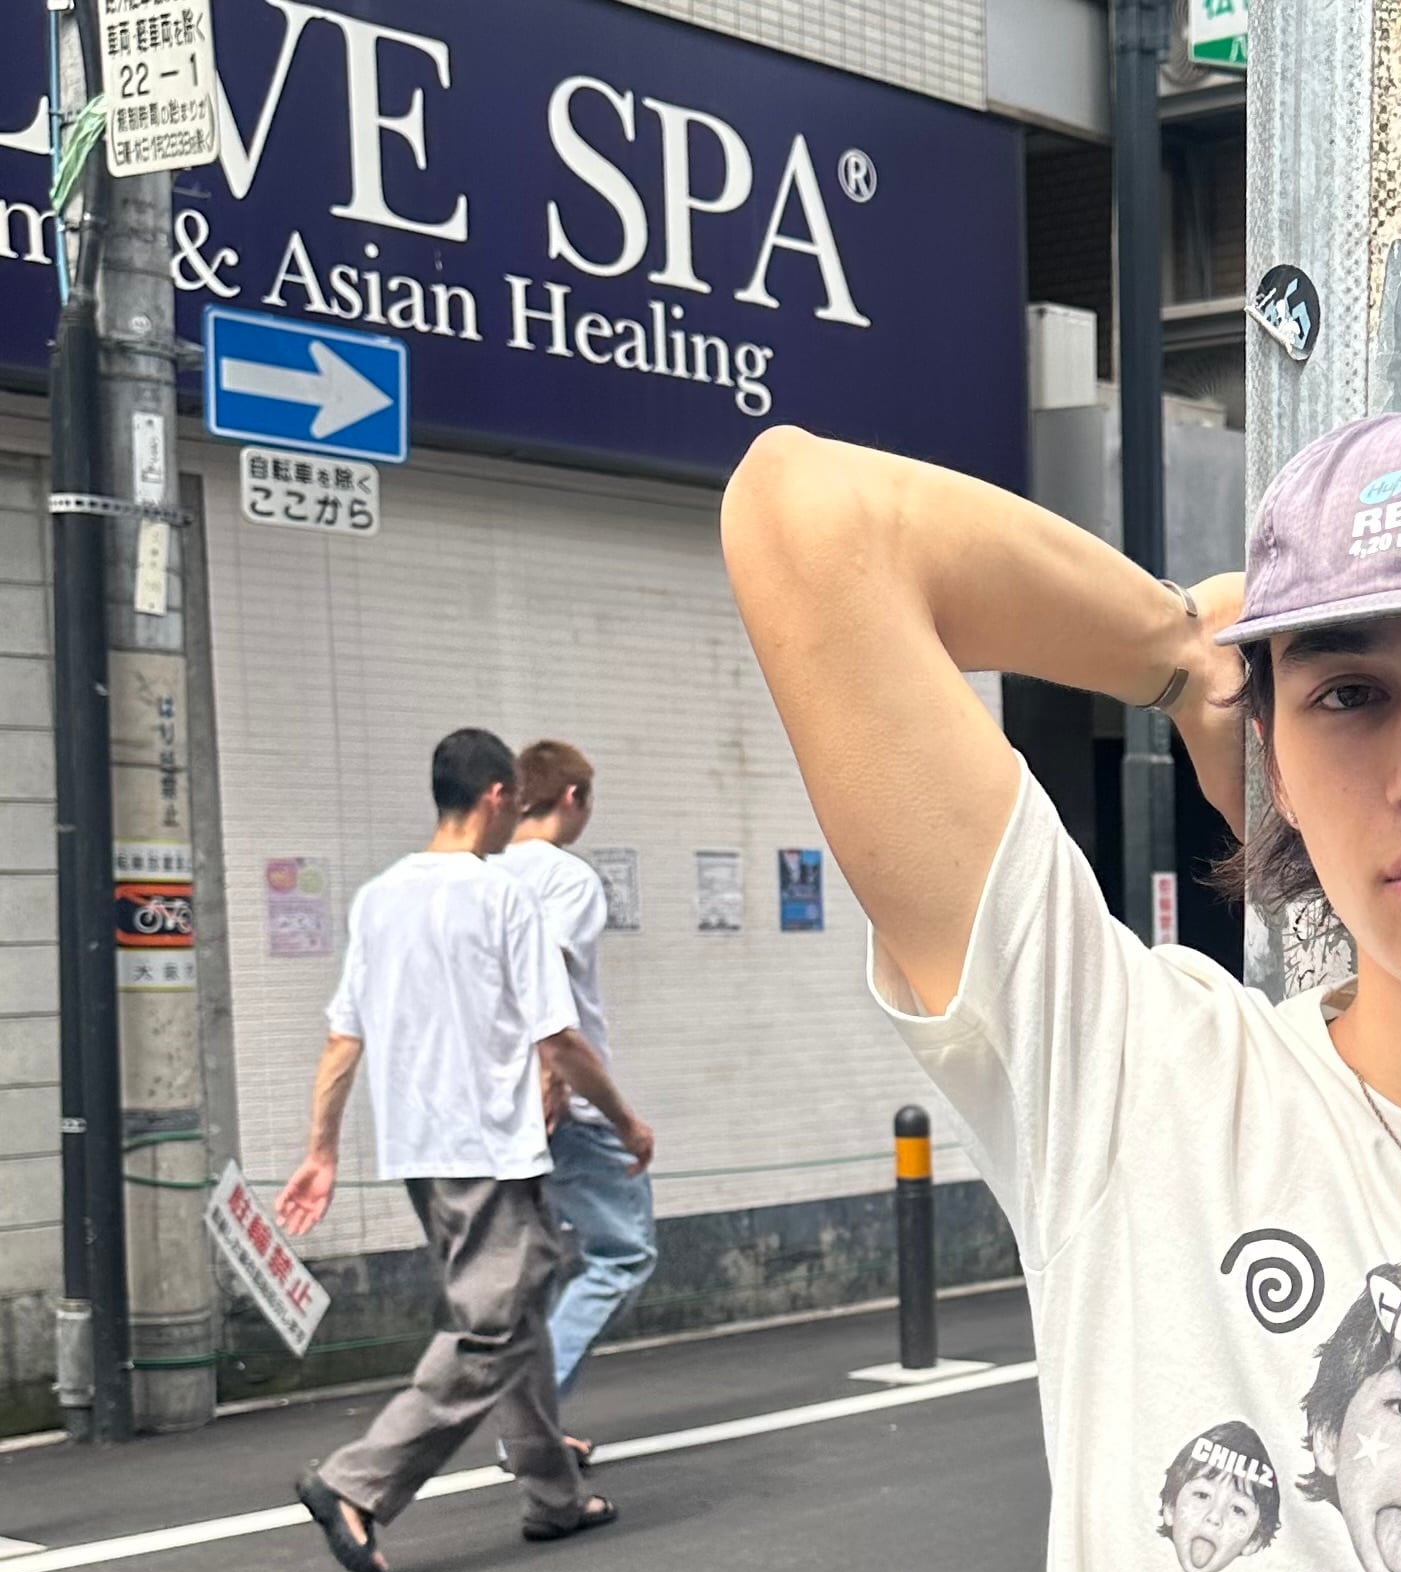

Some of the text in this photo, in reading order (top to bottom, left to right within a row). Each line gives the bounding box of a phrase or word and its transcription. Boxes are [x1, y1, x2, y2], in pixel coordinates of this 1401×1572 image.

[171, 208, 241, 297] &
[262, 230, 483, 340] Asian
[505, 273, 773, 416] Healing
[250, 456, 371, 494] 自転車を除く
[250, 486, 374, 530] ここから
[1191, 1437, 1274, 1488] CHILLZ
